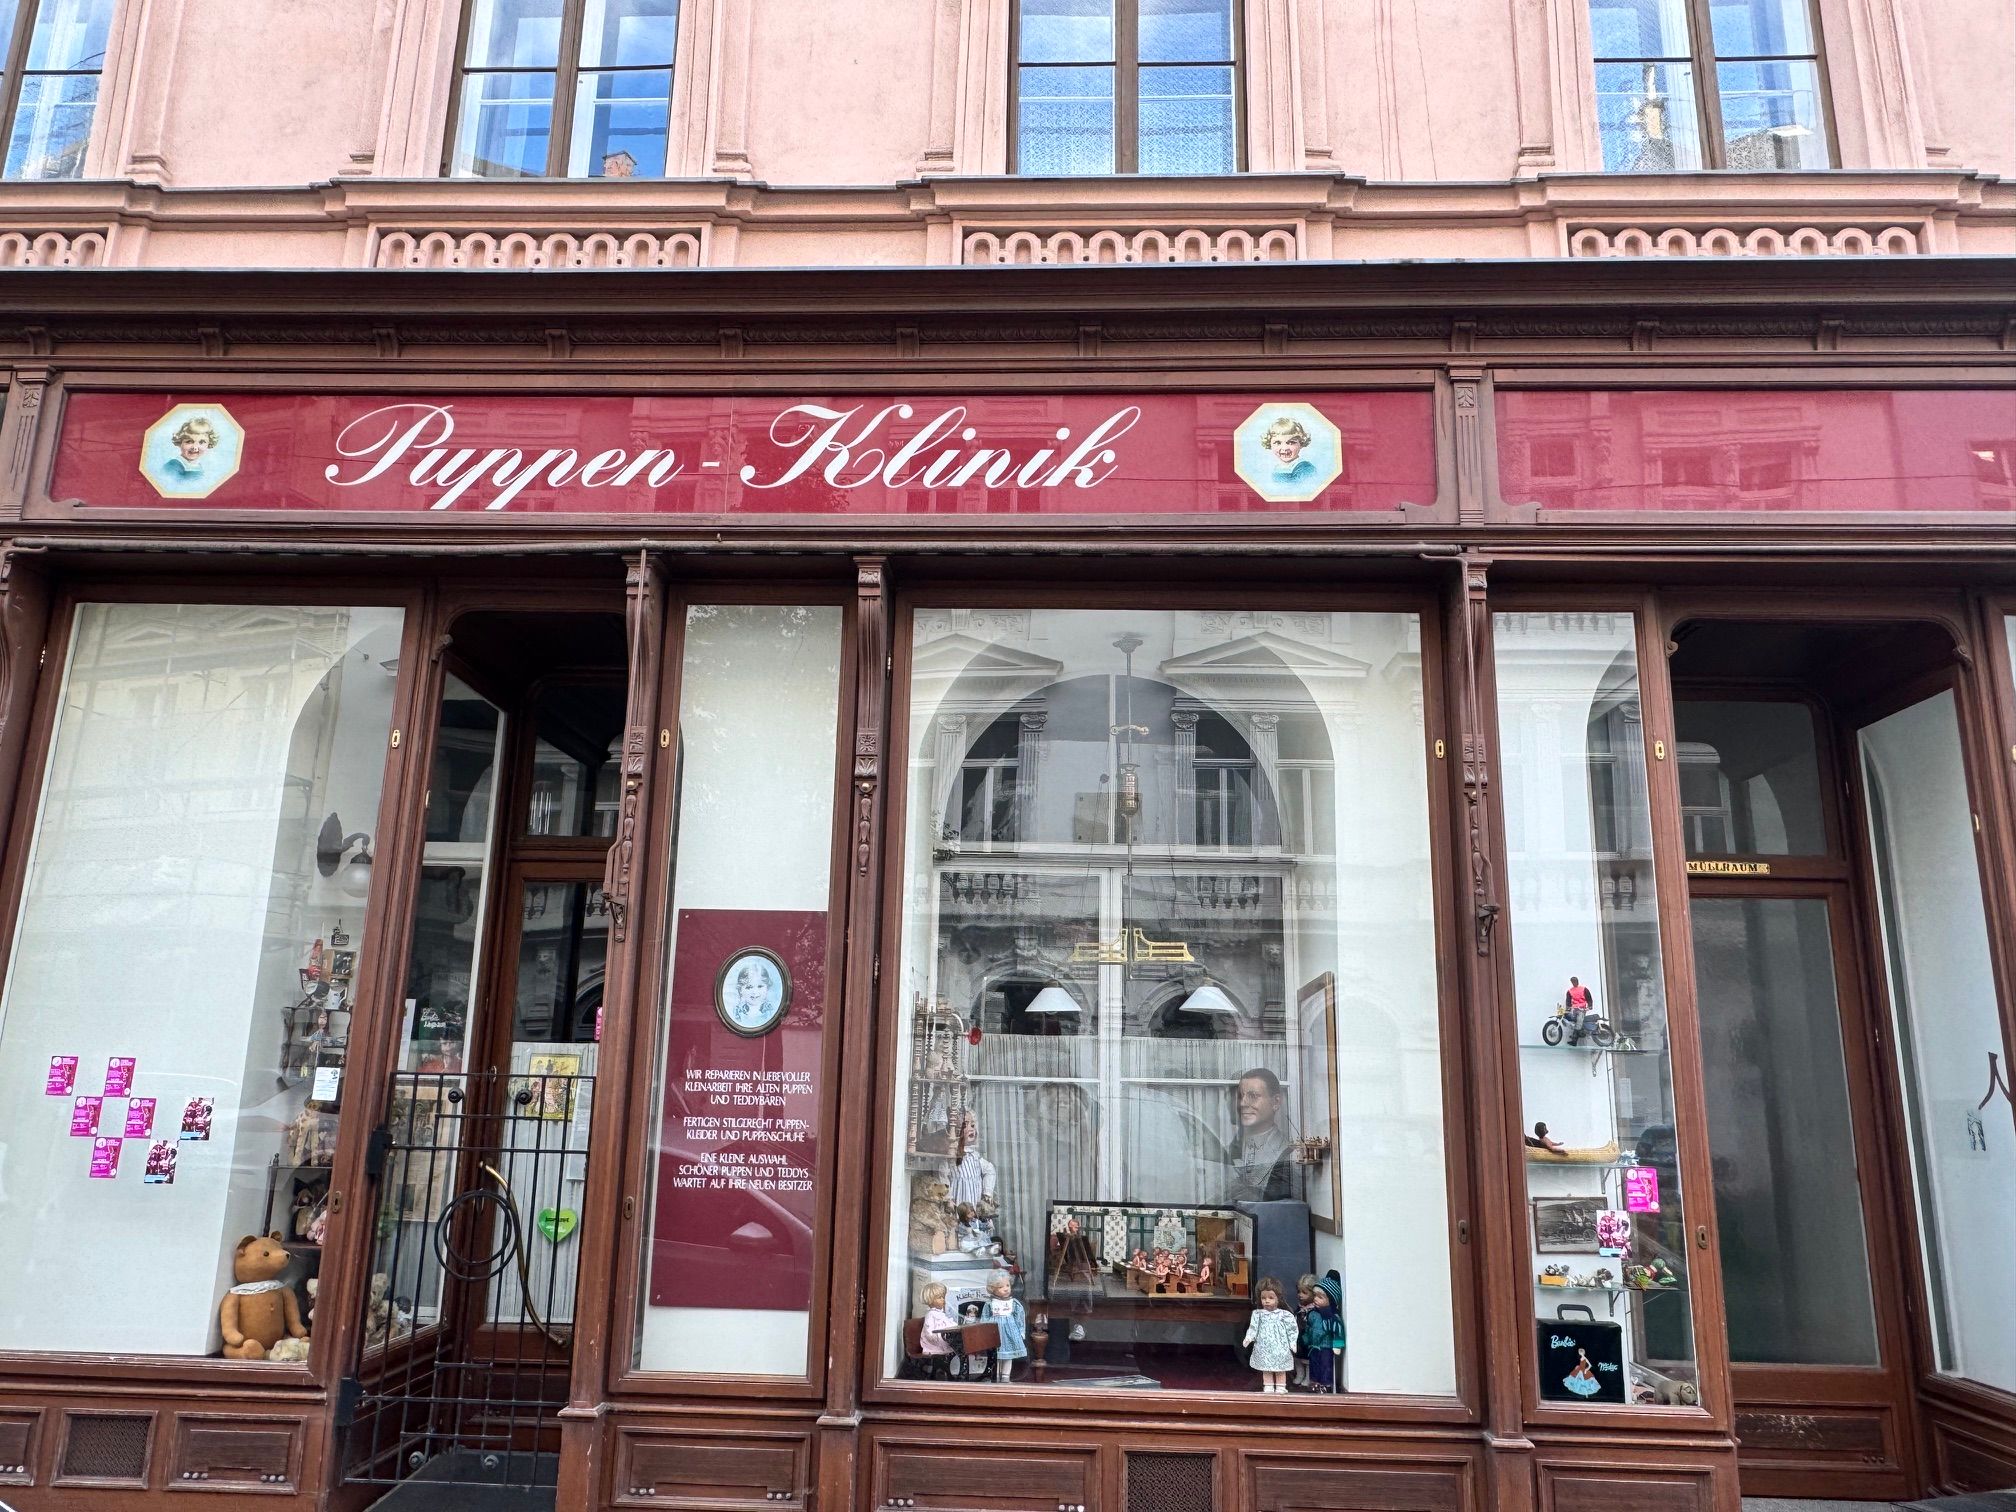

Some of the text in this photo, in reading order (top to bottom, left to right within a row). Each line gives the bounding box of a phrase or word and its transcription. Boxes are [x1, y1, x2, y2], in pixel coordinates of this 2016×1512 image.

[325, 403, 683, 510] Puppen
[740, 403, 1141, 489] Klinik
[1688, 861, 1758, 872] MÜLLRAUM
[686, 1069, 811, 1082] WIR REPARIEREN IN LIEBEVOLLER
[685, 1082, 813, 1094] KLEINARBEIT IHRE ALTEN PUPPEN
[710, 1094, 786, 1106] UND TEDDYBÄREN
[683, 1116, 810, 1130] FERTIGEN STILGERECHT PUPPEN-
[687, 1129, 805, 1142] KLEIDER UND PUPPENSCHUHE
[700, 1152, 788, 1165] EINE KLEINE AUSWAHL
[679, 1163, 809, 1178] SCHÖNER PUPPEN UND TEDDYS
[673, 1177, 813, 1191] WARTET AUF IHRE NEUEN BESITZER
[1550, 1335, 1576, 1349] Barbie
